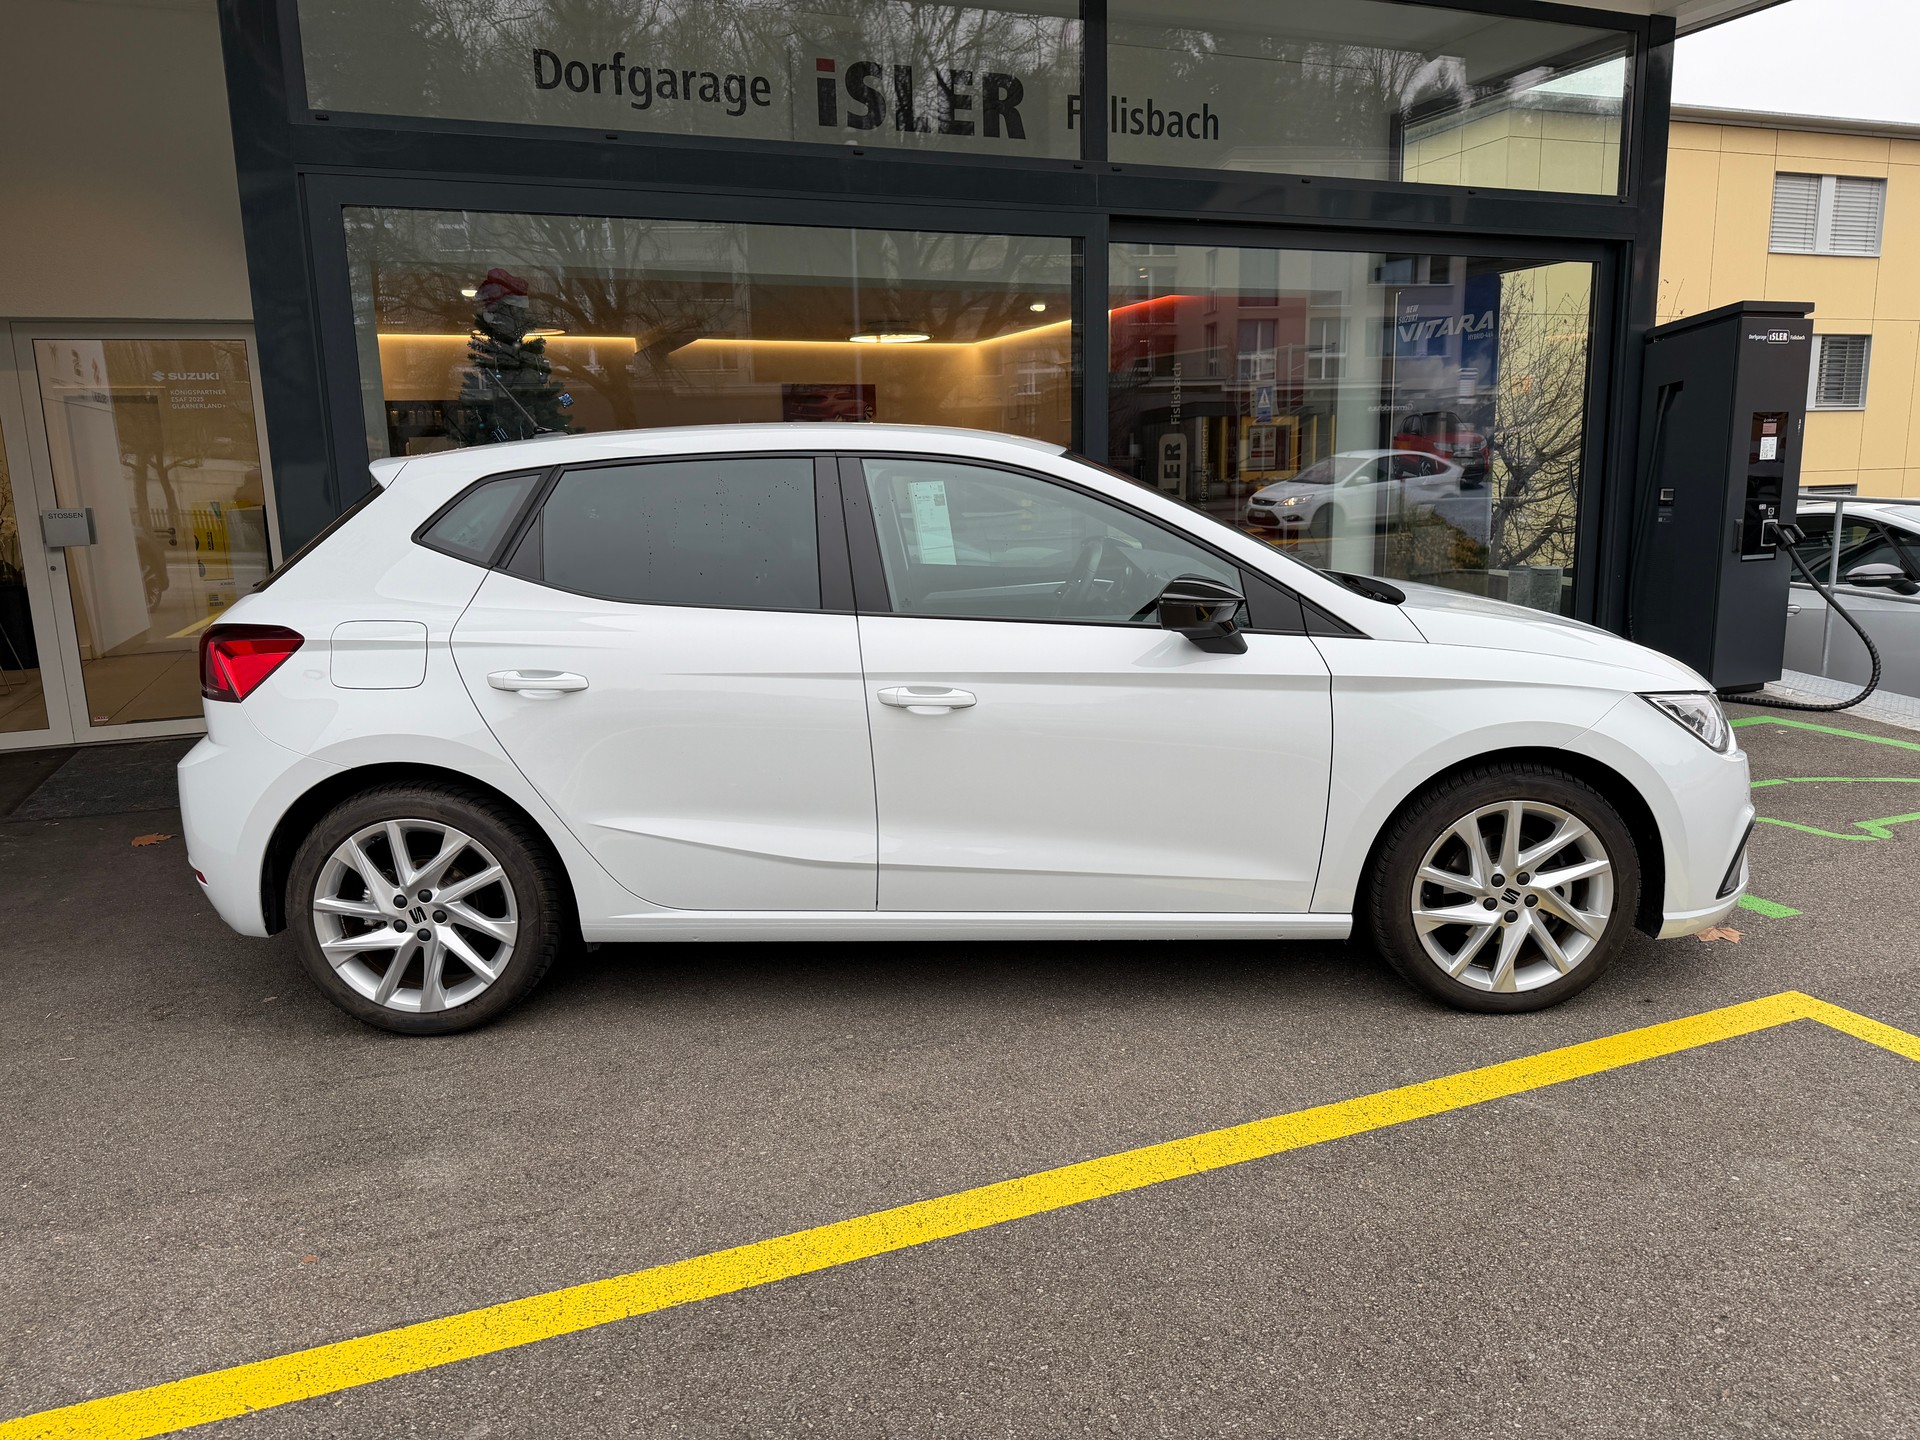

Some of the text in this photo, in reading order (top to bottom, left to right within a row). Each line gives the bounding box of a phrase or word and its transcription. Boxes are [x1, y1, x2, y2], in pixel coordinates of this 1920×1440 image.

[532, 48, 1220, 140] Dorfgarage iSLER Flisbach
[1398, 310, 1495, 343] VITARA
[1769, 332, 1788, 341] iSLER
[168, 372, 219, 381] SUZUKI
[1170, 361, 1182, 425] Fislisbach
[1163, 443, 1181, 498] LER
[48, 512, 84, 520] STOSSEN
